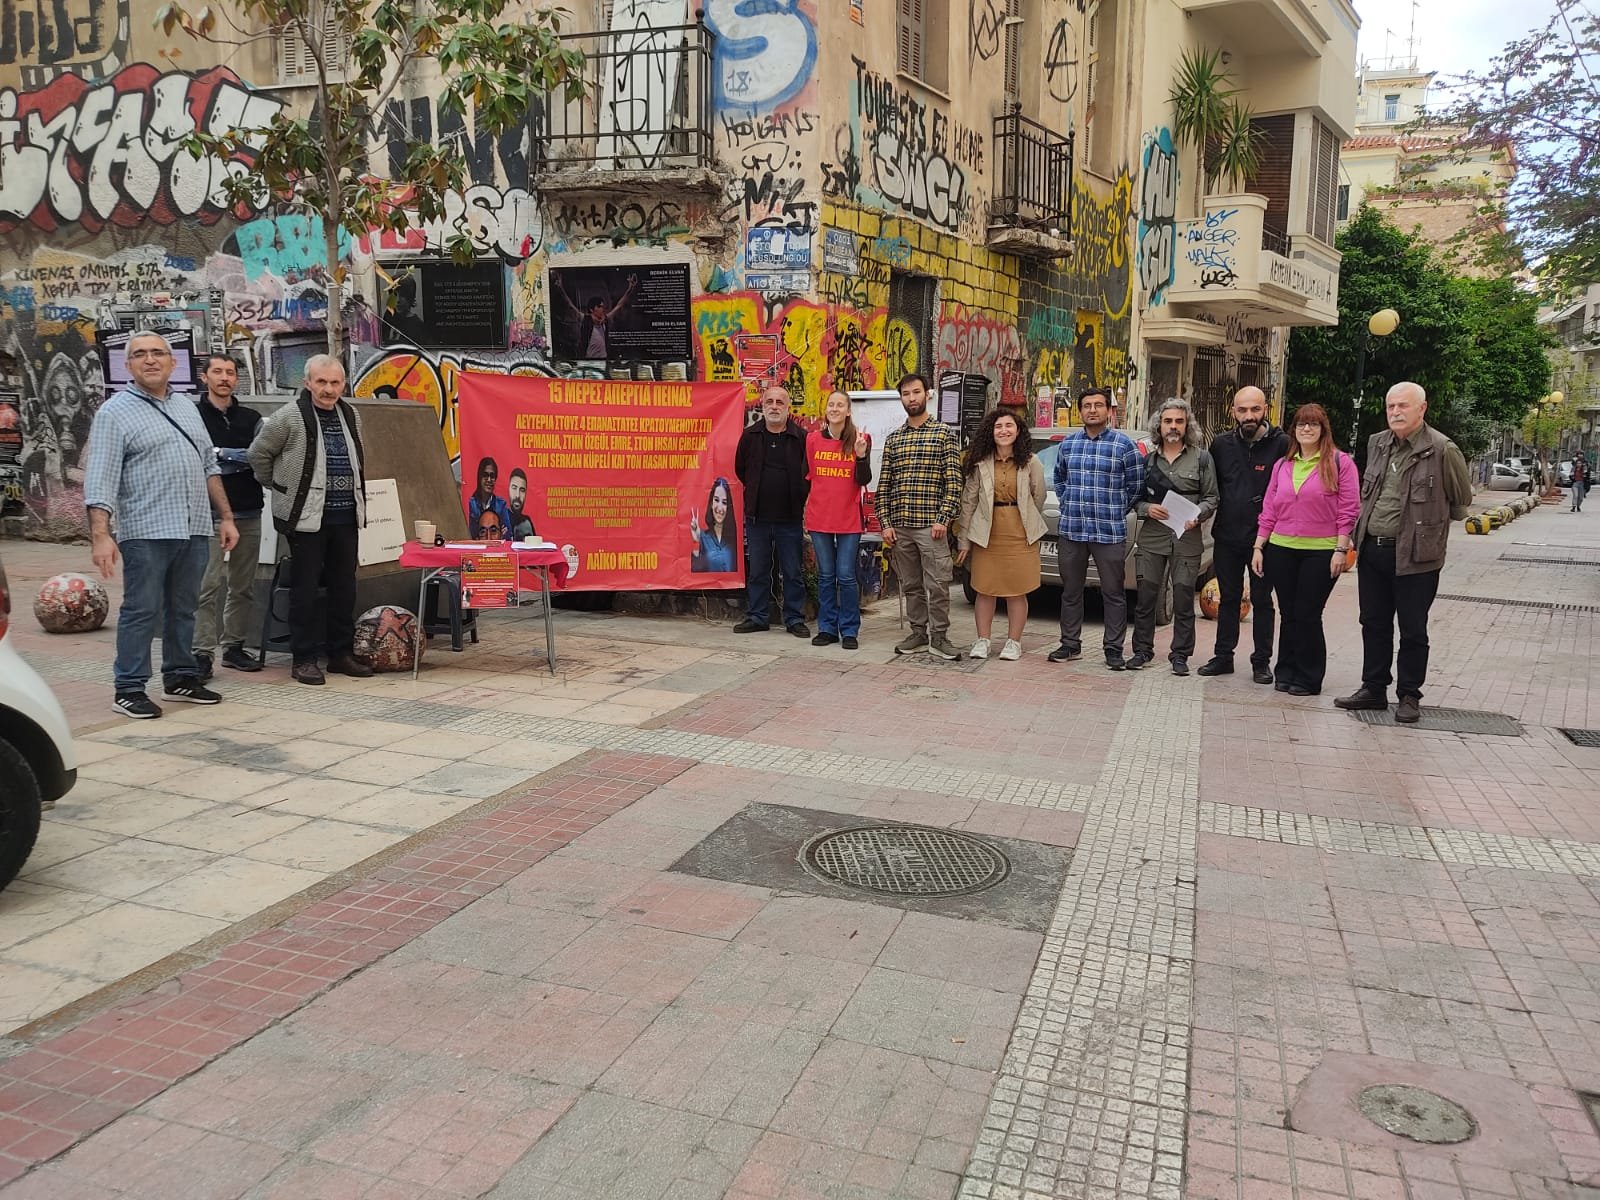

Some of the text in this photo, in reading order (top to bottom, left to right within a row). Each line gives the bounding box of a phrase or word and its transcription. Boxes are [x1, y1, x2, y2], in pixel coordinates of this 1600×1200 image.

[1187, 229, 1238, 247] ANGER
[548, 382, 693, 408] 15 ΜΕΡΕΣ ΑΠΕΡΓΙΑ ΠΕΙΝΑΣ
[516, 414, 554, 430] ΛΕΥΤΕΡΙΑ
[555, 415, 579, 431] ΣΤΟΥΣ
[528, 453, 549, 468] ΣΤΟΝ
[550, 454, 583, 468] SERKAN
[816, 466, 852, 478] ΠΕΙΝΑΣ
[587, 550, 617, 570] ΛΑΪΚΟ
[618, 551, 658, 570] ΜΕΤΩΠΟ
